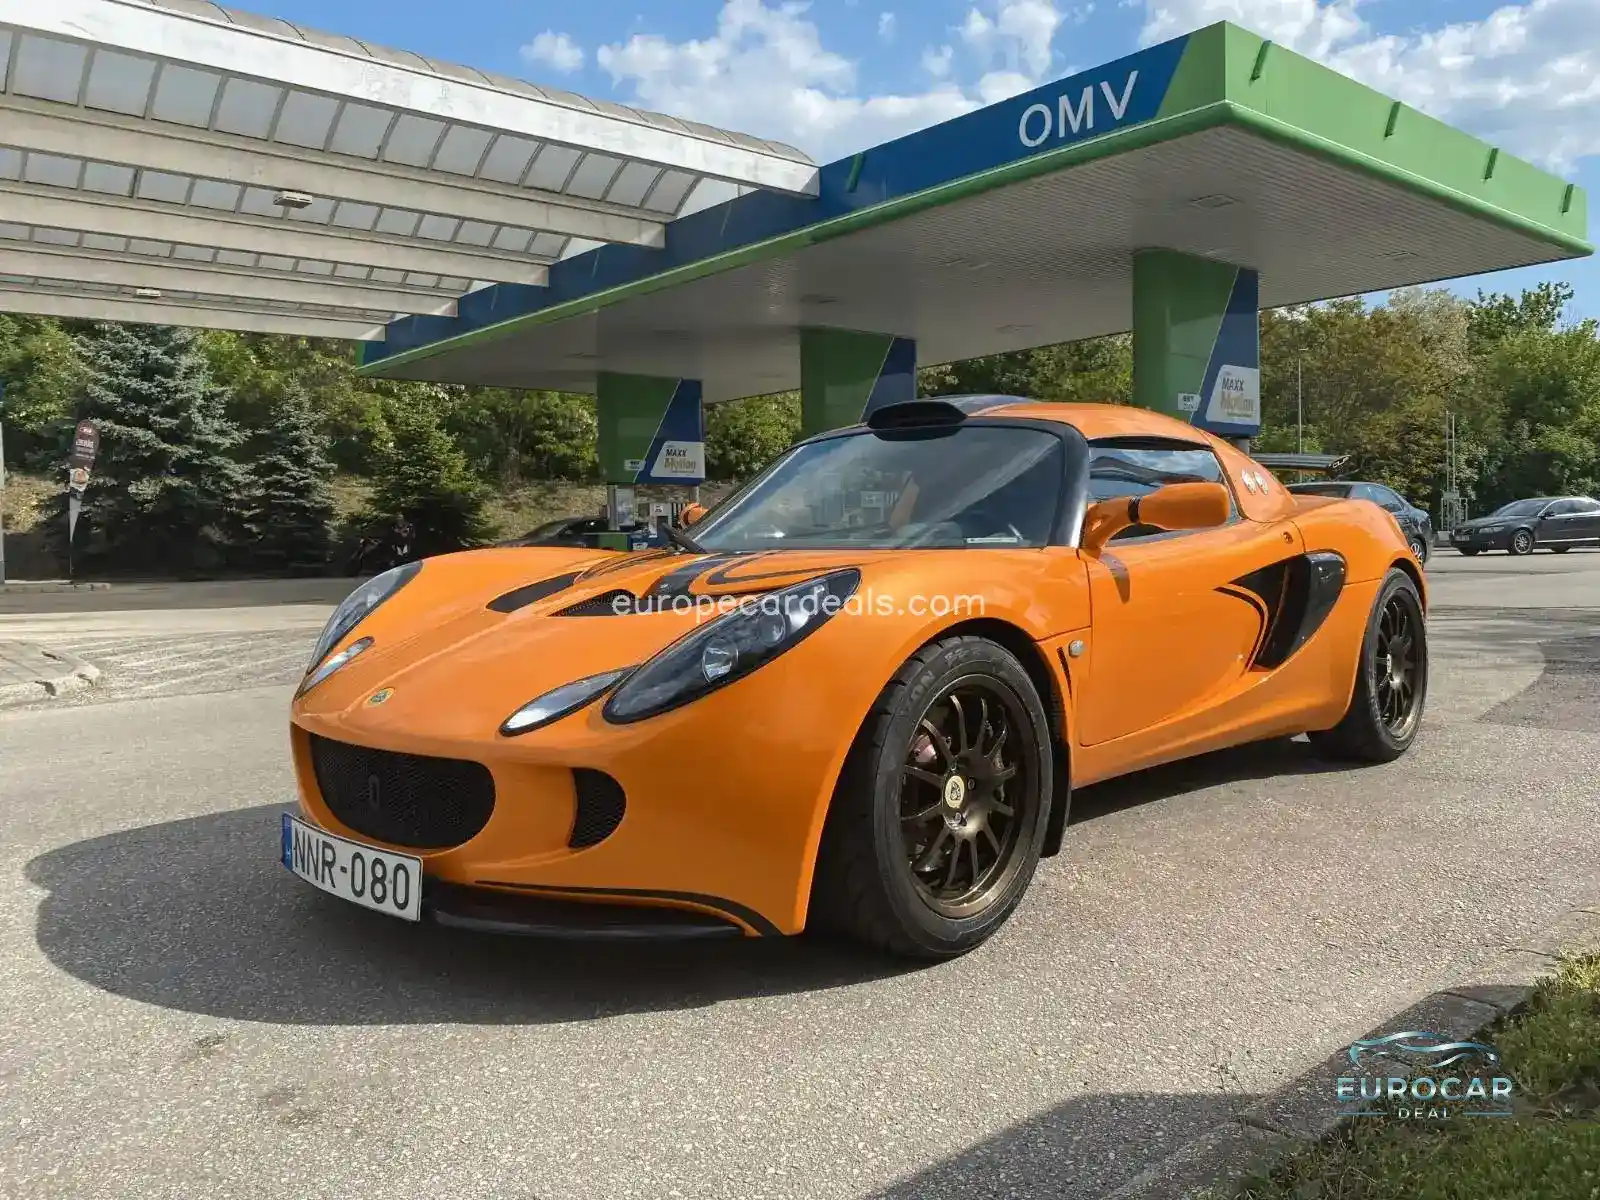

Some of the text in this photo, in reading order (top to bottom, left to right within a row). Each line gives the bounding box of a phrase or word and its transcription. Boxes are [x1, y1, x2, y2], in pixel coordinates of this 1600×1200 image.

[1019, 70, 1139, 147] OMV
[1221, 377, 1244, 391] MAXX
[665, 448, 688, 457] MAXX
[294, 827, 410, 910] NNR-080
